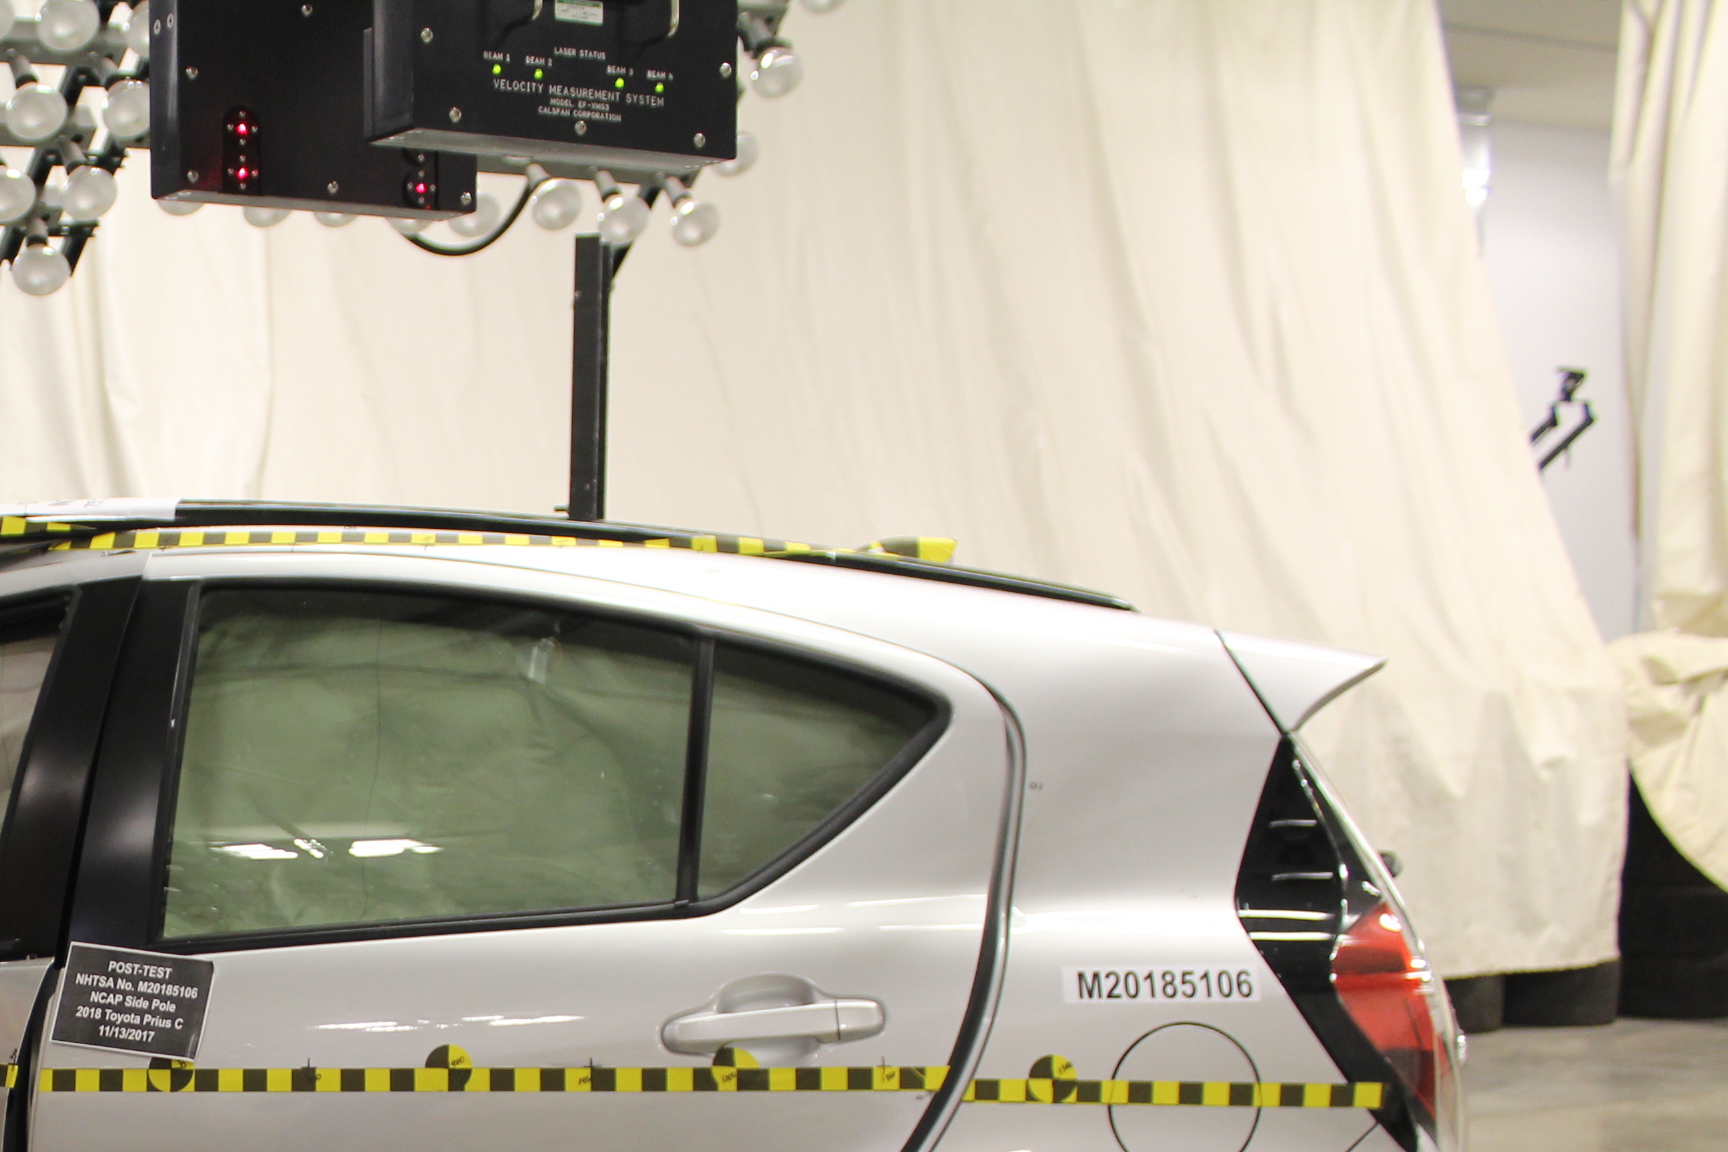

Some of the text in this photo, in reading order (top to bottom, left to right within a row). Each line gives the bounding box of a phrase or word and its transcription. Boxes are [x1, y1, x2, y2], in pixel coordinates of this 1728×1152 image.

[483, 51, 503, 60] BEAM
[525, 55, 545, 64] BEAM
[554, 47, 606, 60] LASER STATUS
[607, 65, 626, 74] BEAM
[647, 69, 666, 79] BEAM
[493, 78, 664, 106] VELOCITY MEASUREMENT SYSTEM
[538, 106, 622, 122] CALSPAN CORPORATION
[108, 960, 173, 979] POST-TEST
[75, 973, 198, 999] NHTSA No. M20185106
[1077, 969, 1254, 999] M20185106
[90, 991, 176, 1013] NCAP Side Pole
[75, 1005, 184, 1030] 2018 Toyota Prius C
[98, 1025, 155, 1043] 11/13/2017
